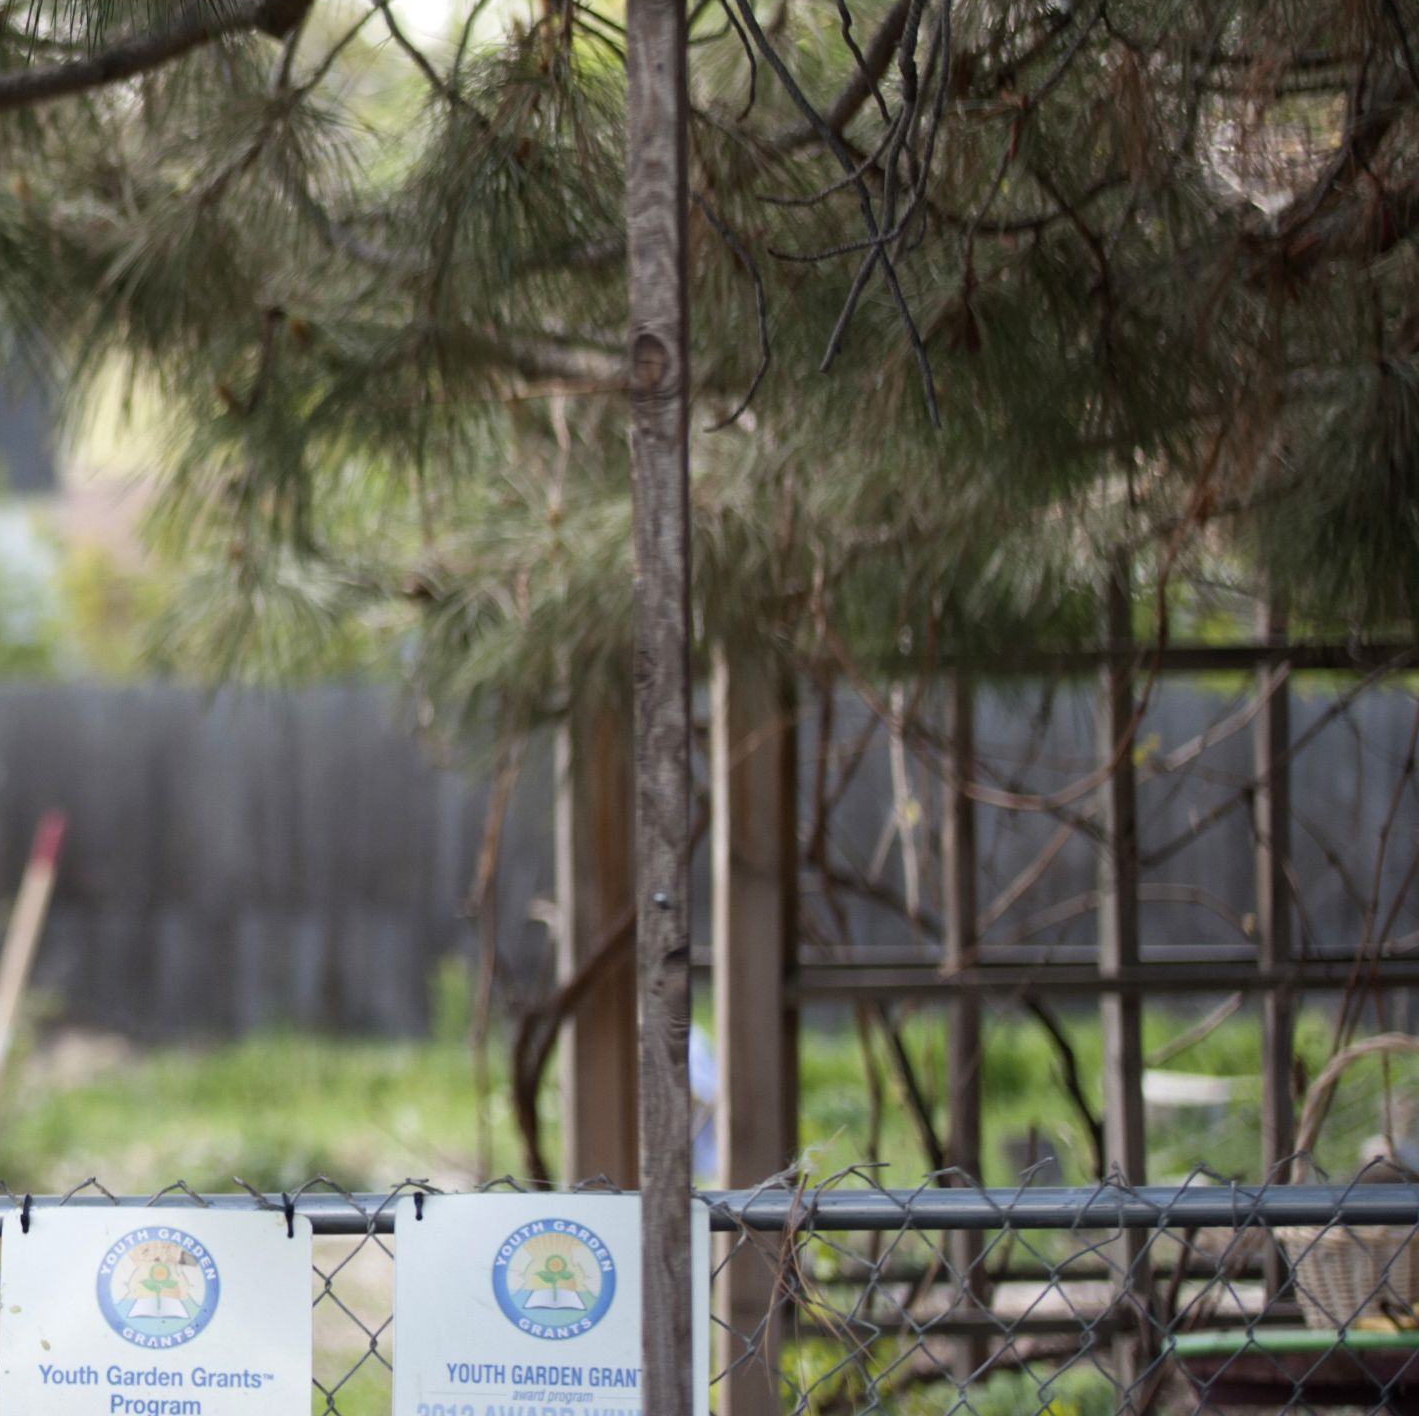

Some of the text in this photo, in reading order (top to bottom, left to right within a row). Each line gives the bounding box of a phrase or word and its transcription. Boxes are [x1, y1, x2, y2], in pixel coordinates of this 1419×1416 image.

[100, 1228, 217, 1281] YOUTH GARDEN
[495, 1220, 612, 1272] YOUTH GARDEN
[122, 1325, 196, 1349] GRANTS
[518, 1317, 593, 1339] GRANTS
[39, 1365, 99, 1385] Youth
[106, 1366, 183, 1387] Garden
[447, 1364, 642, 1387] YOUTH GARDEN GRAN
[110, 1394, 201, 1416] Program
[512, 1389, 593, 1404] award program
